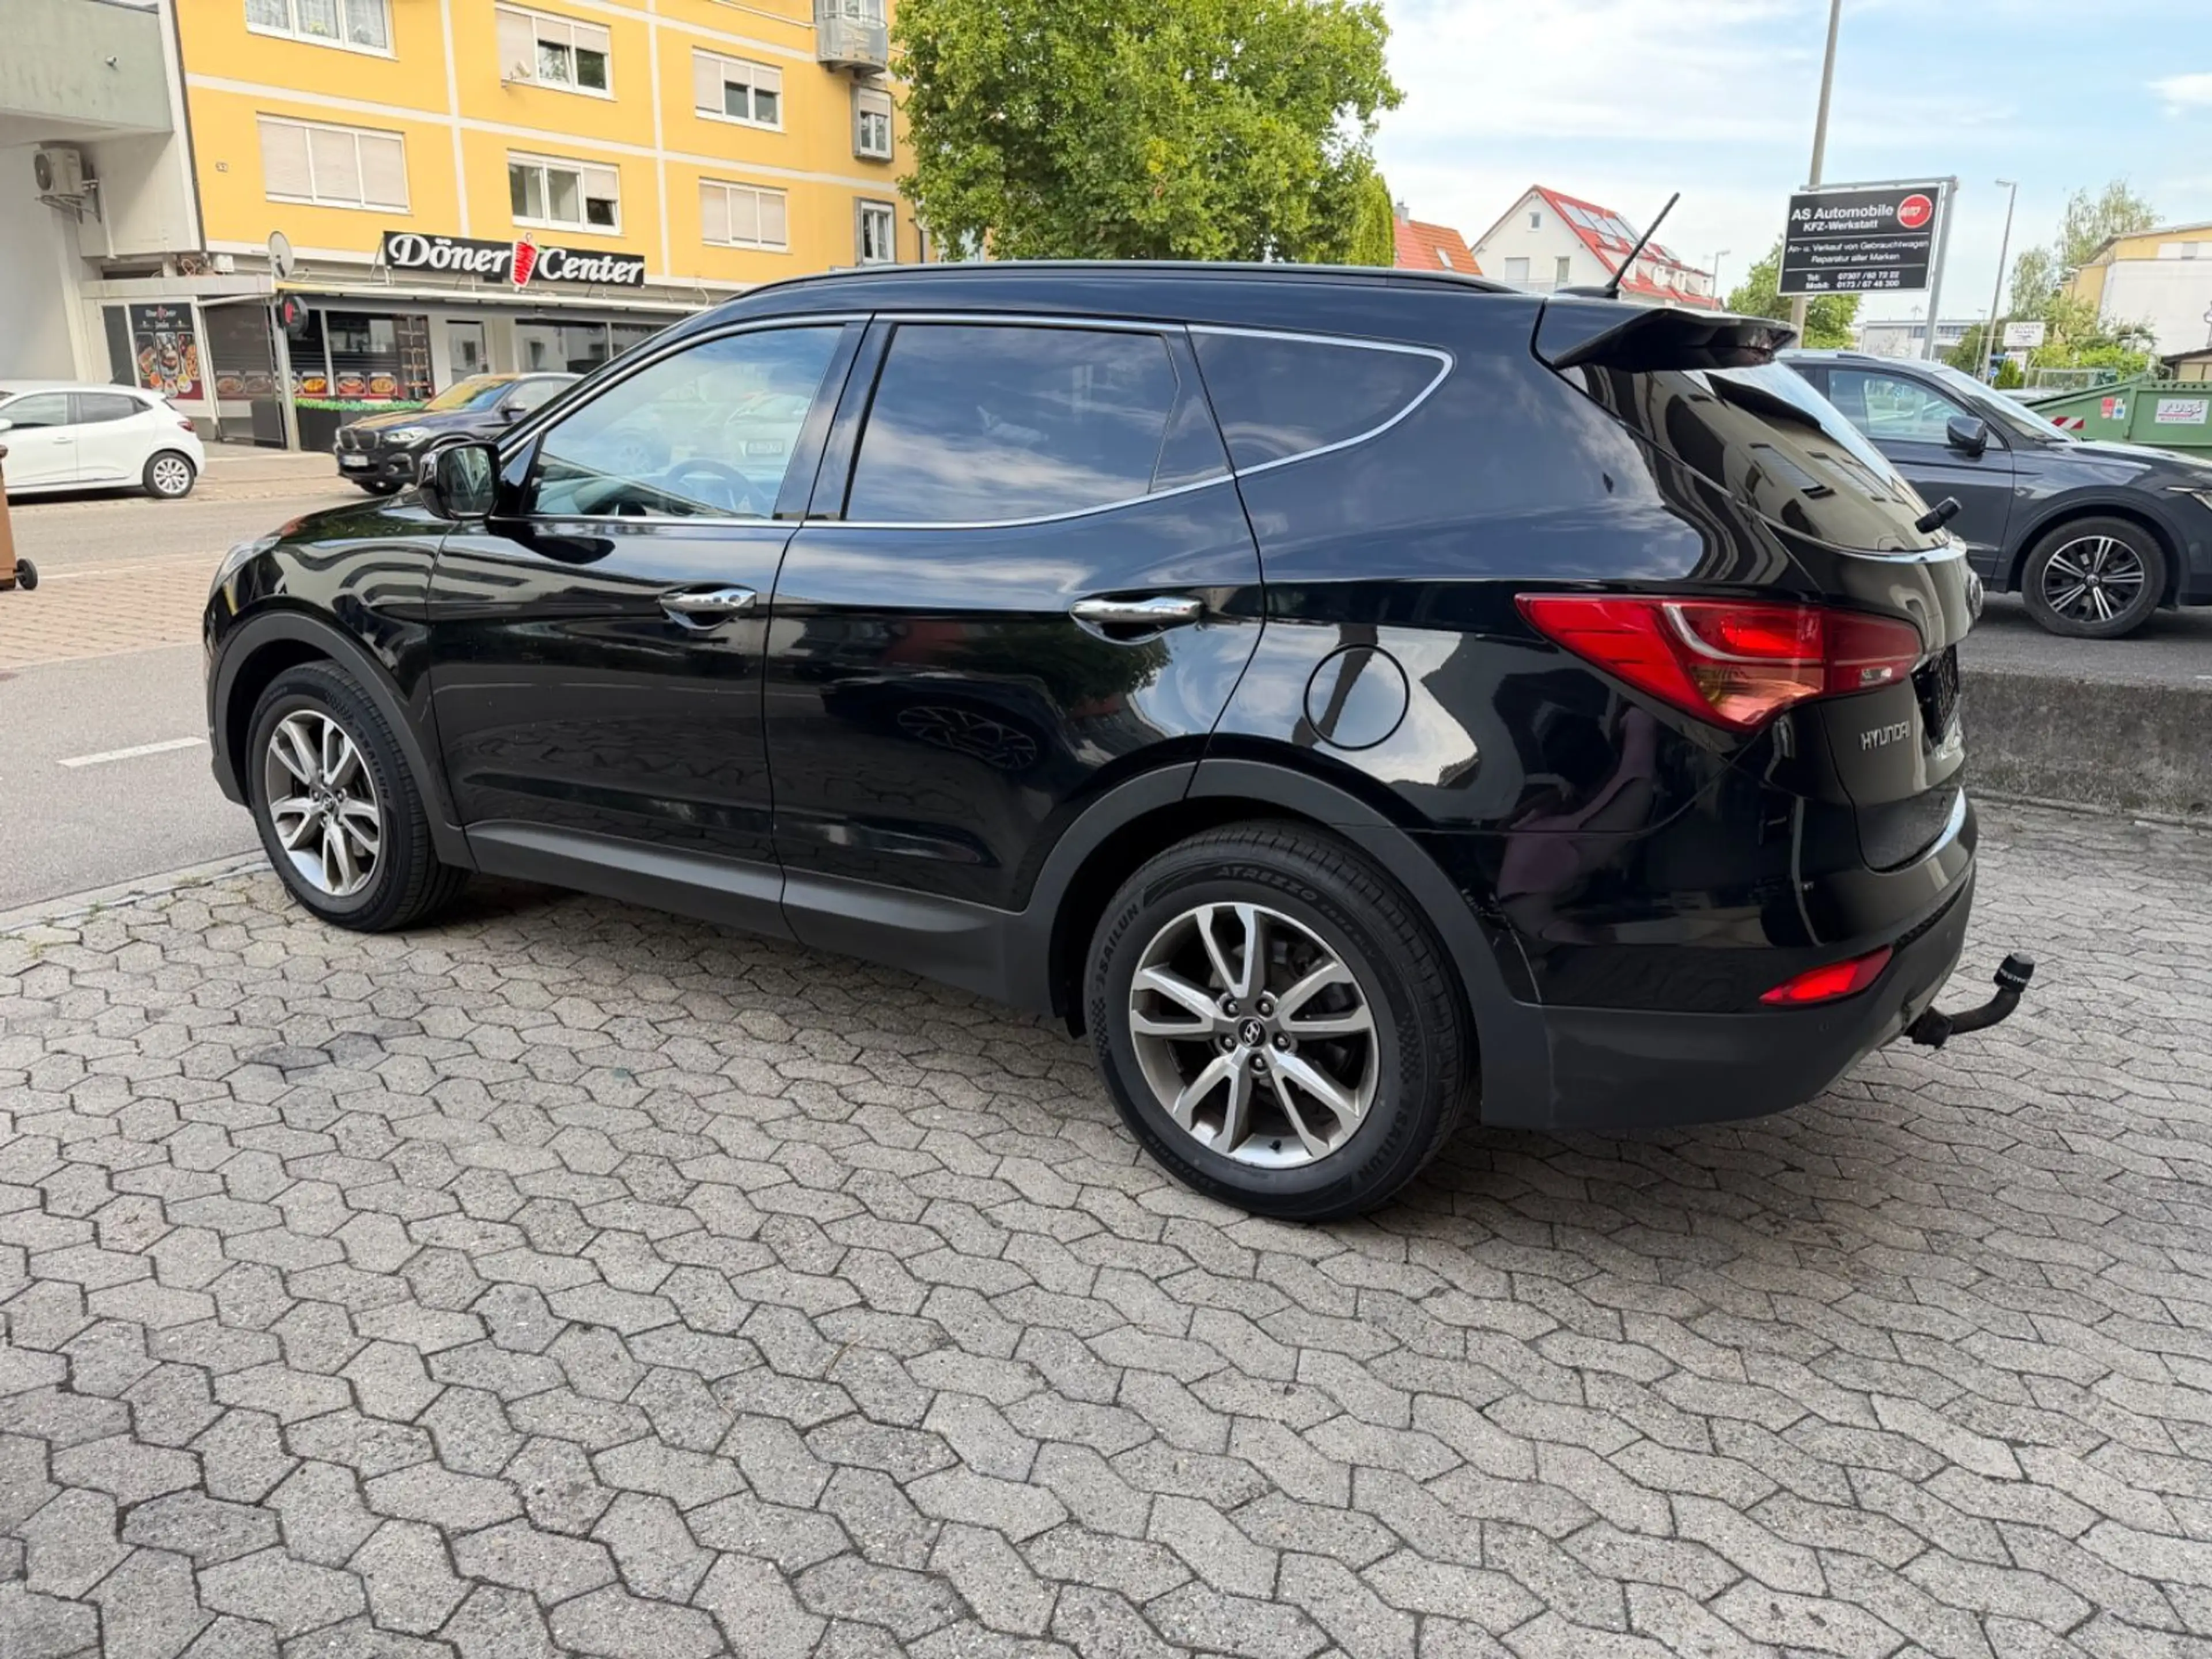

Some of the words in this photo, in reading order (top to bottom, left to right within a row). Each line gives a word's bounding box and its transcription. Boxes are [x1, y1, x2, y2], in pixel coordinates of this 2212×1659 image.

[1791, 208, 1810, 221] AS
[1814, 204, 1894, 219] Automobile
[1803, 220, 1878, 232] KFZ-Werkstatt
[388, 233, 512, 272] Döner
[538, 248, 644, 284] Center
[1860, 719, 1911, 751] HYUNDAI
[1215, 866, 1318, 900] ATREZZO
[1099, 903, 1139, 975] SAILUN
